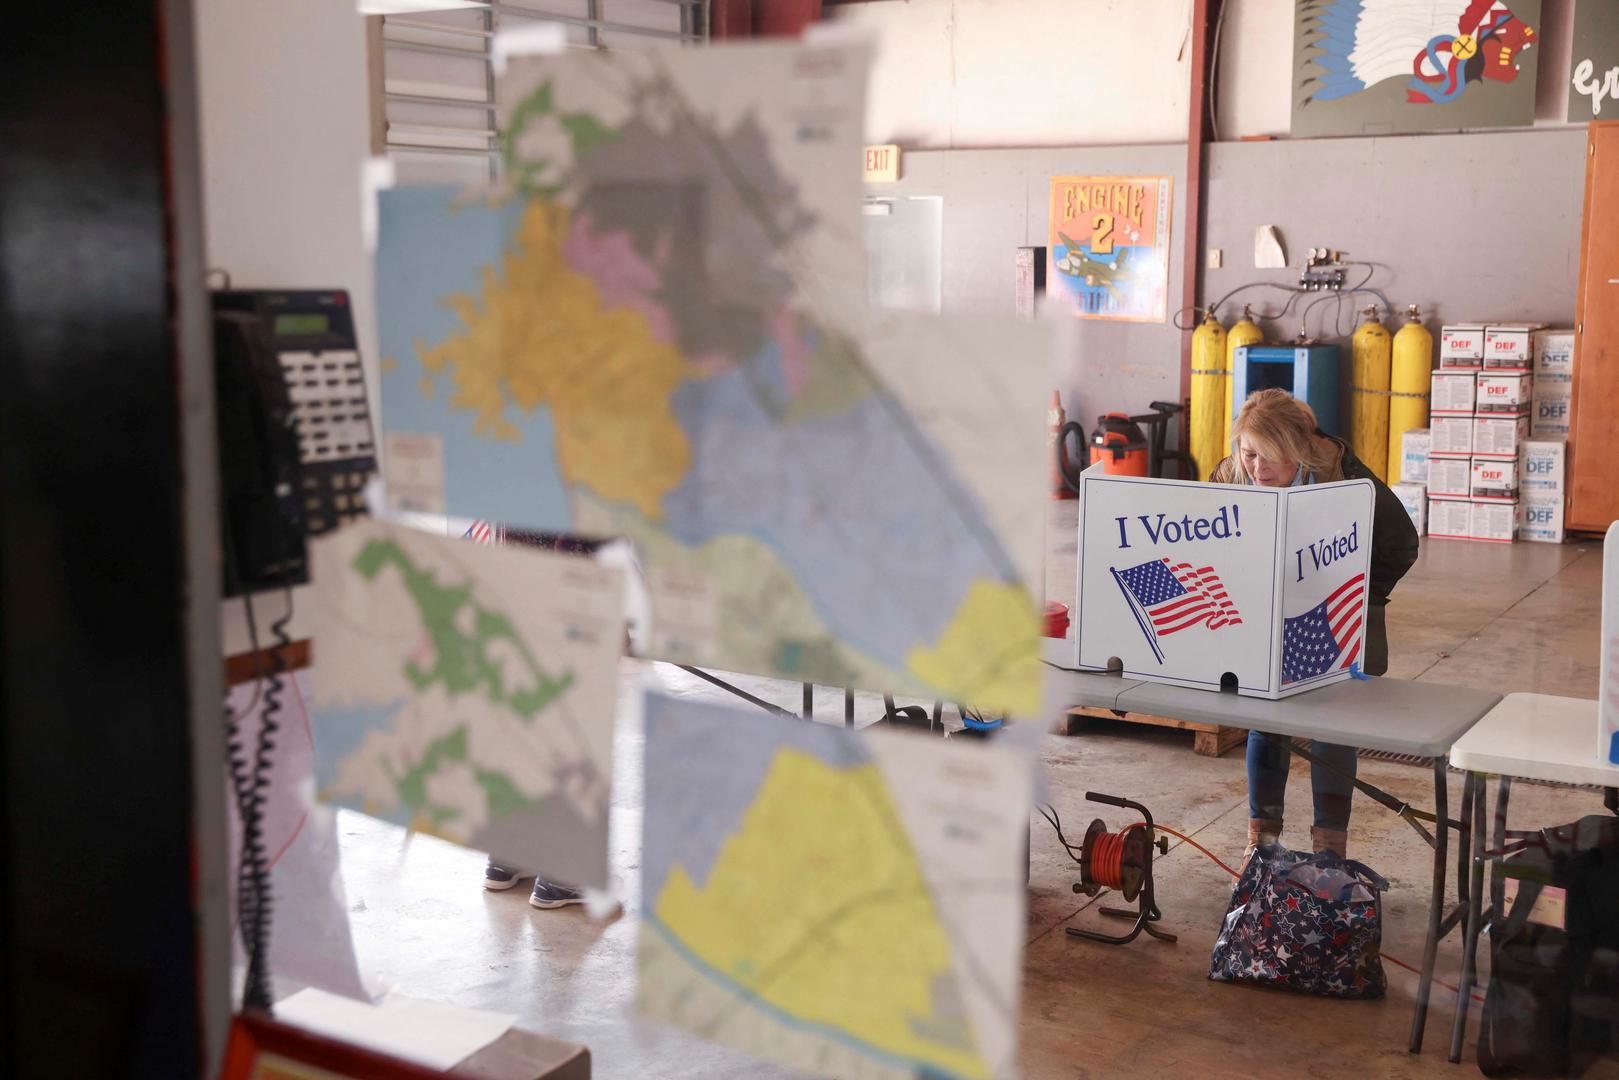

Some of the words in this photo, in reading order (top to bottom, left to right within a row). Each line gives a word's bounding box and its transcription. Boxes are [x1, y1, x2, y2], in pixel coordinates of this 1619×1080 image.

[866, 149, 890, 171] EXIT
[1063, 185, 1144, 227] ENGINE
[1090, 213, 1115, 255] 2
[1451, 340, 1472, 348] DEF
[1495, 342, 1517, 350] DEF
[1487, 386, 1509, 394] DEF
[1539, 405, 1567, 417] DEF
[1526, 461, 1553, 473] DEF
[1481, 471, 1503, 479] DEF
[1526, 510, 1553, 523] DEF
[1115, 516, 1132, 549] I
[1138, 504, 1242, 545] Voted!
[1295, 548, 1304, 583] I
[1309, 521, 1359, 572] Voted
